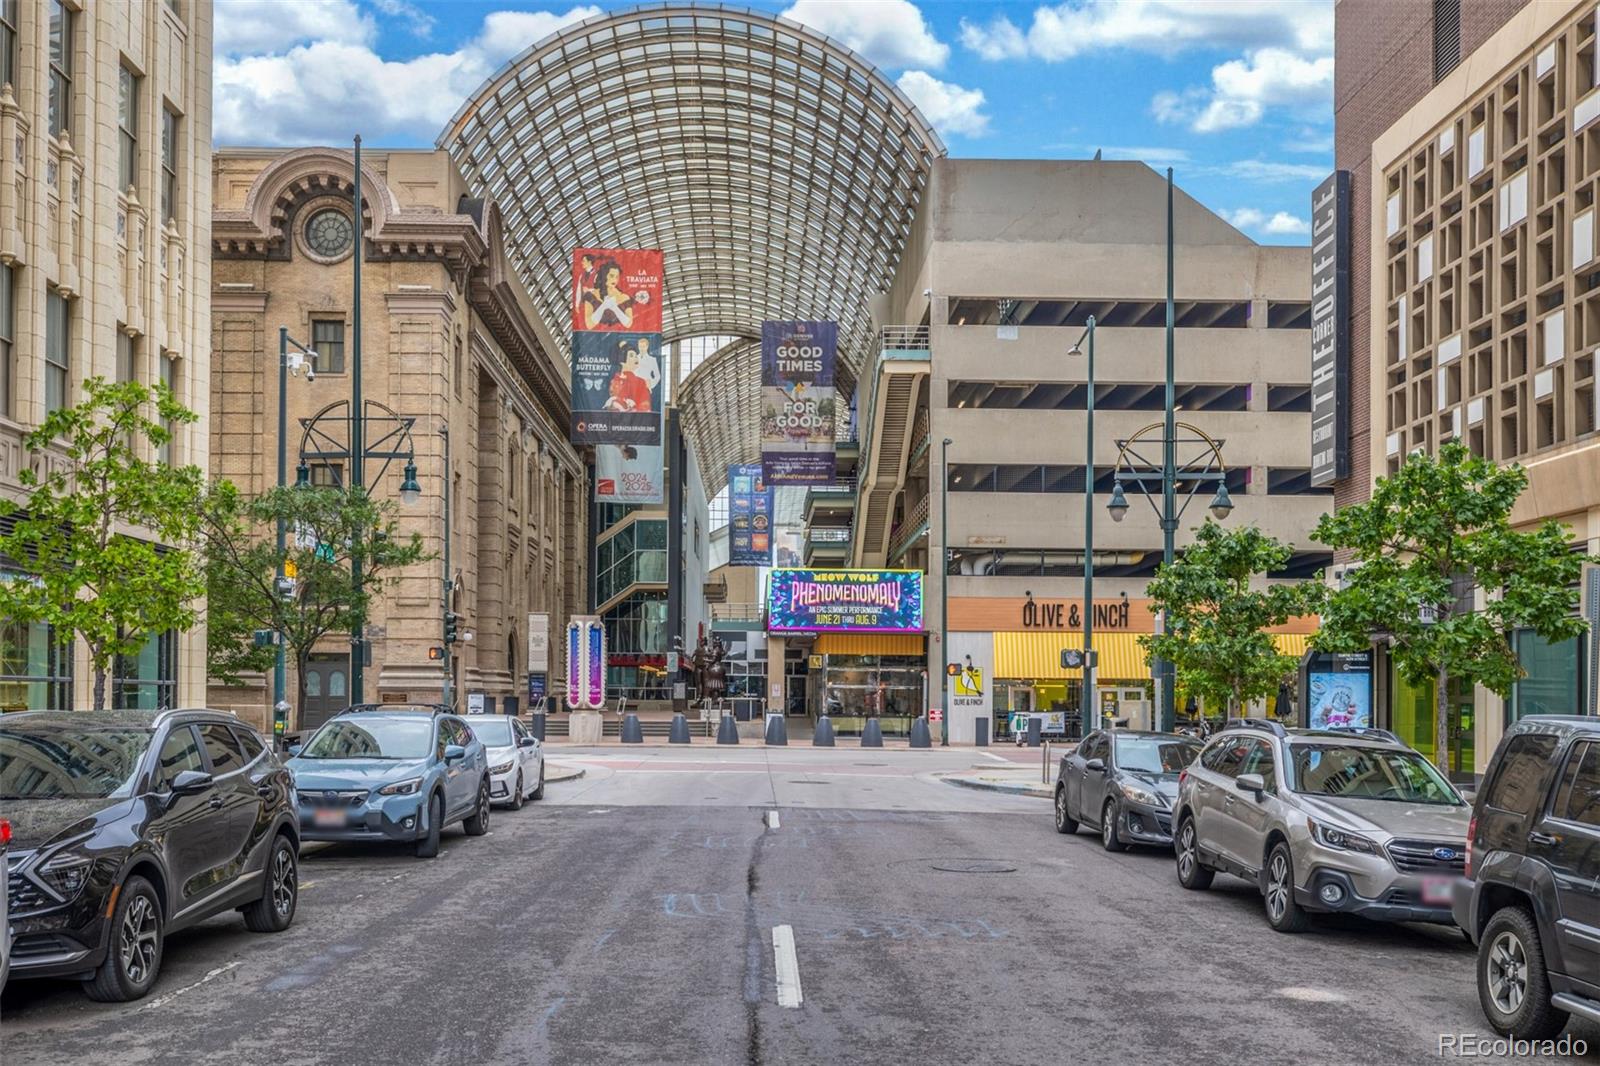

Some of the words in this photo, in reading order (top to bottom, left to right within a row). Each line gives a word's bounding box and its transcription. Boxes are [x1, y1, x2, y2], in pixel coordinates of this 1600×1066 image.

[1313, 185, 1334, 321] OFFICE
[626, 275, 658, 283] TRAVIATA
[1313, 315, 1334, 344] CORNER
[776, 346, 823, 358] GOOD
[576, 363, 612, 371] BUTTERFLY
[776, 360, 823, 372] TIMES
[1313, 338, 1334, 412] THE
[784, 402, 816, 414] FOR
[776, 415, 823, 428] GOOD
[621, 472, 647, 482] 2024
[625, 482, 652, 491] 2025
[814, 573, 847, 582] MEOW
[847, 573, 880, 582] WOLF
[791, 581, 901, 612] PHENOMENOMALY
[828, 606, 849, 614] SUMMER
[849, 606, 884, 614] PERFORMANCE
[1023, 604, 1064, 627] OLIVE
[1068, 604, 1081, 627] &
[1092, 604, 1129, 628] INCH
[815, 614, 833, 625] JUNE
[833, 614, 841, 625] 21
[841, 615, 855, 624] THRU
[855, 614, 871, 625] AUG.
[871, 614, 877, 625] 9
[954, 698, 965, 706] OLIVE
[970, 698, 983, 706] FINCH
